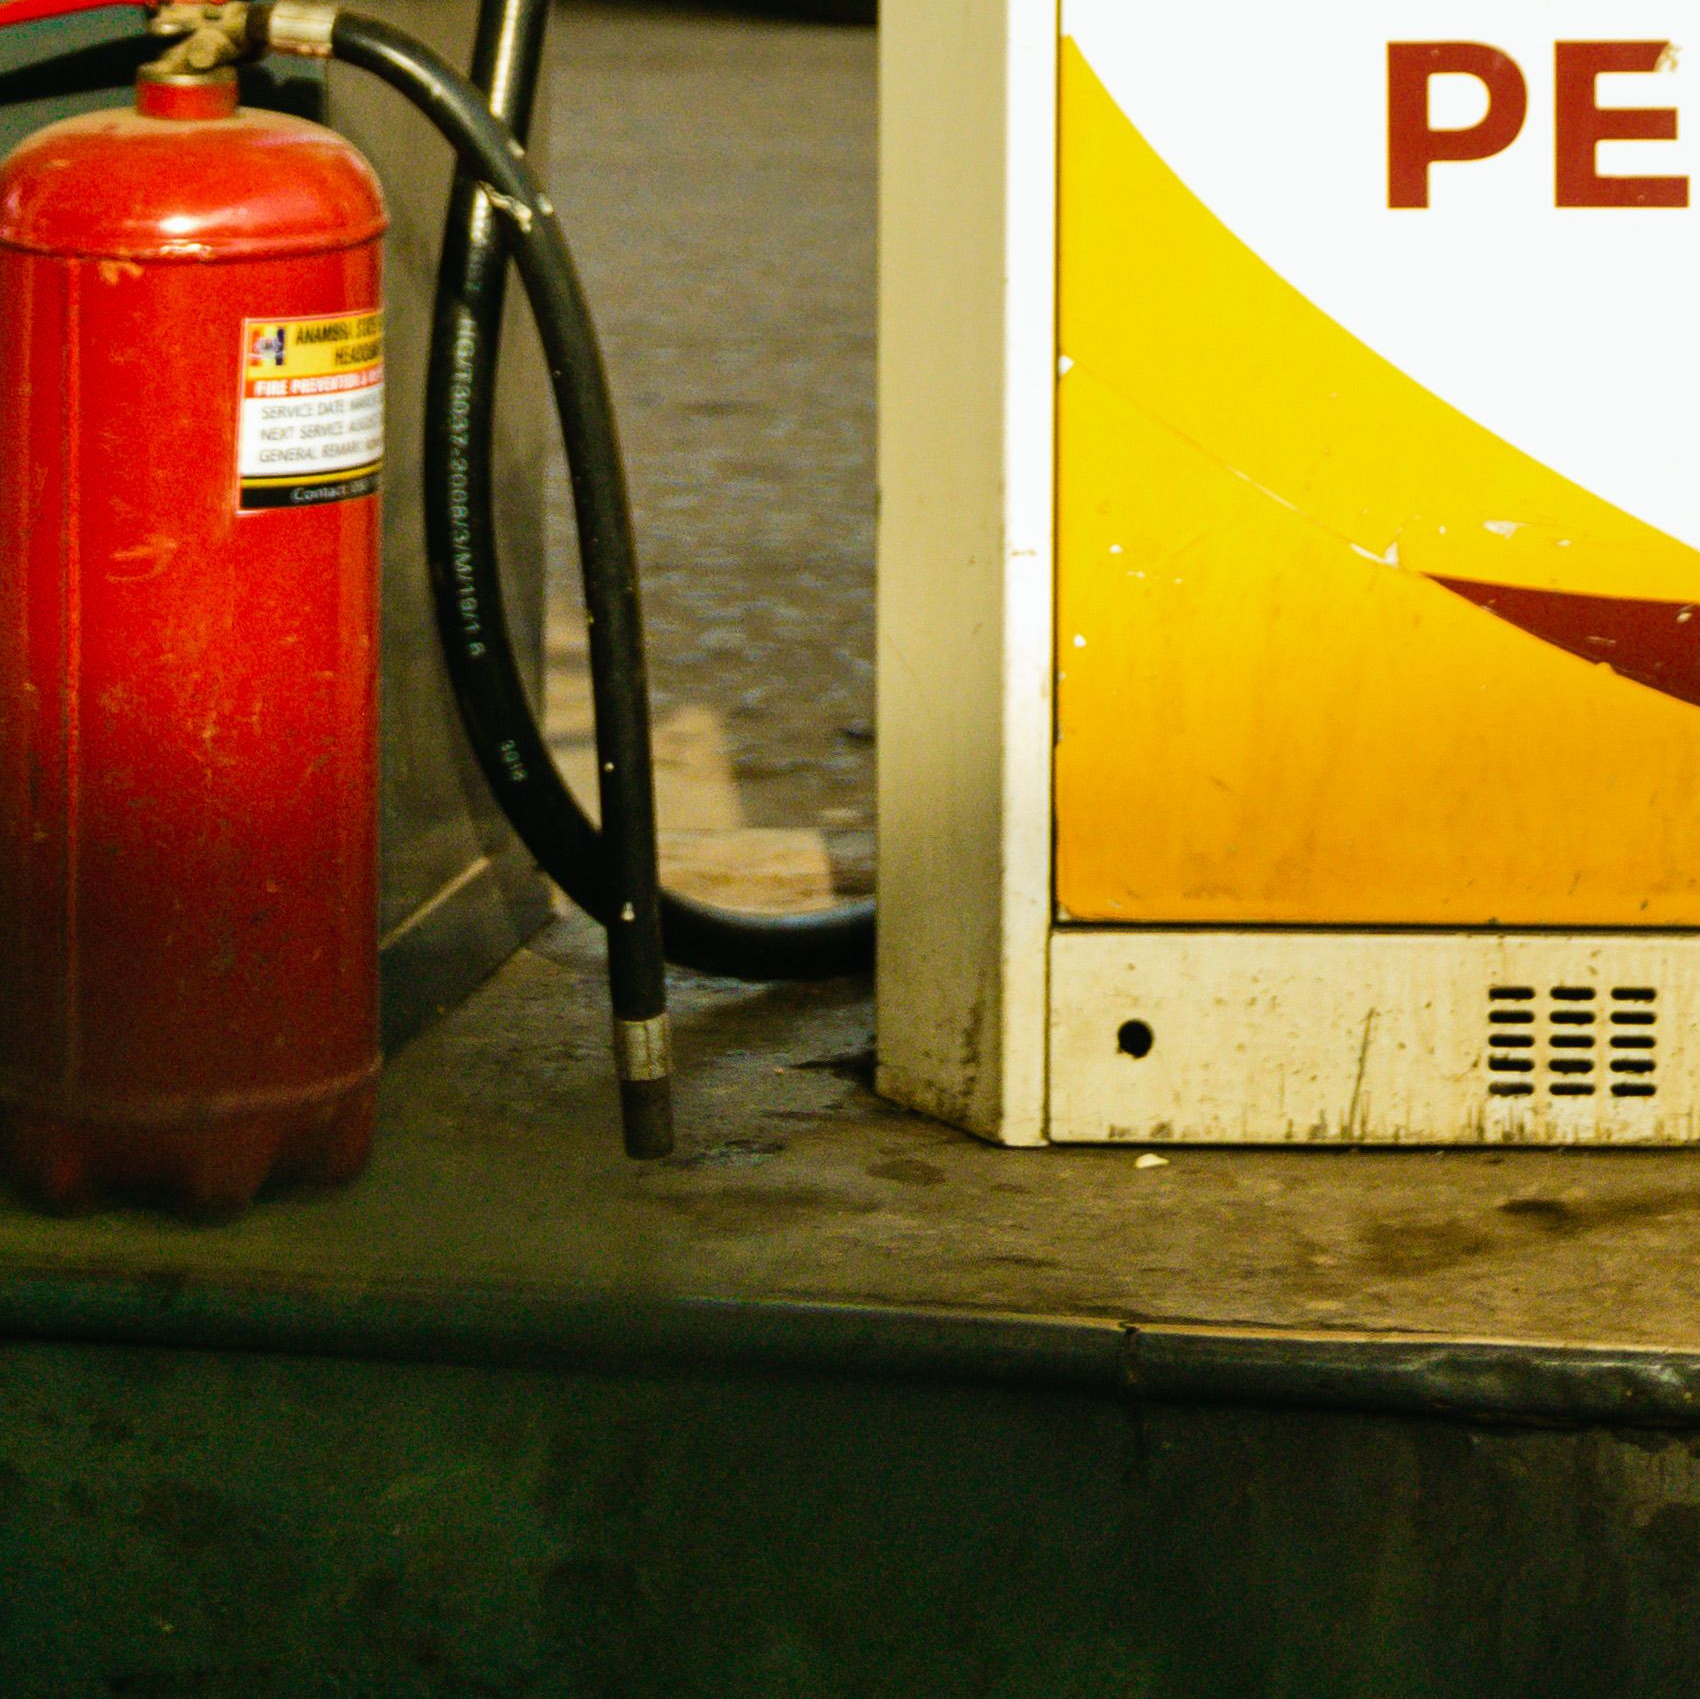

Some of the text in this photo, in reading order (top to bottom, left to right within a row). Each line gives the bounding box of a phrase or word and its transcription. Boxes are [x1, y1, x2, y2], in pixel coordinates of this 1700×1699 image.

[254, 378, 288, 398] FIRE
[261, 404, 313, 420] SERVICE
[317, 398, 345, 416] DATE
[260, 424, 295, 442] NEXT
[299, 419, 343, 440] SERVICE
[258, 447, 319, 463] GENERAL
